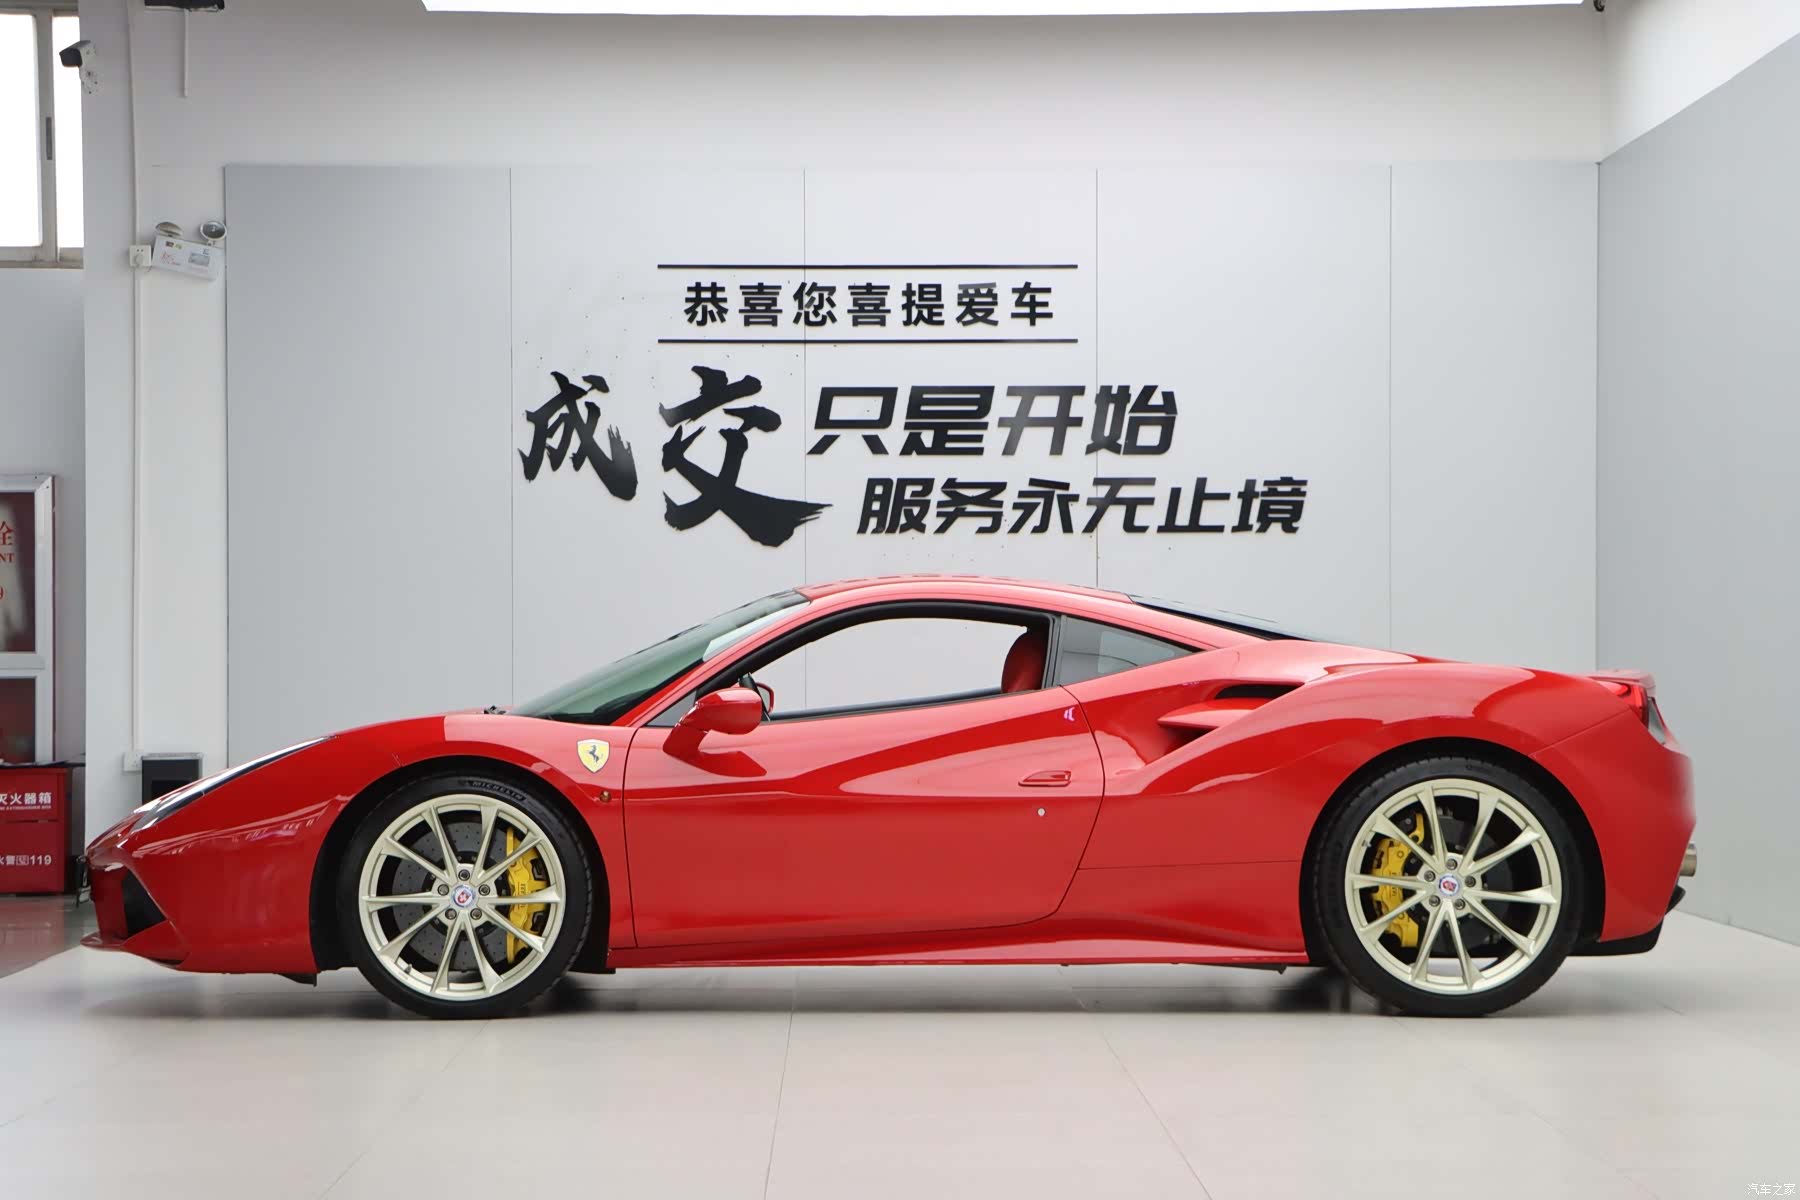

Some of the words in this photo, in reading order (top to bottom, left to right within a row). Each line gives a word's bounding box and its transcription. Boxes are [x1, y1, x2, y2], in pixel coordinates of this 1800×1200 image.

[684, 281, 1053, 327] 恭喜您喜提爱车
[519, 365, 833, 548] 成交
[806, 384, 1178, 456] 只是开始
[856, 476, 1308, 535] 服务永无止境
[0, 792, 52, 805] 灭火器箱
[472, 780, 523, 800] MICHELIN
